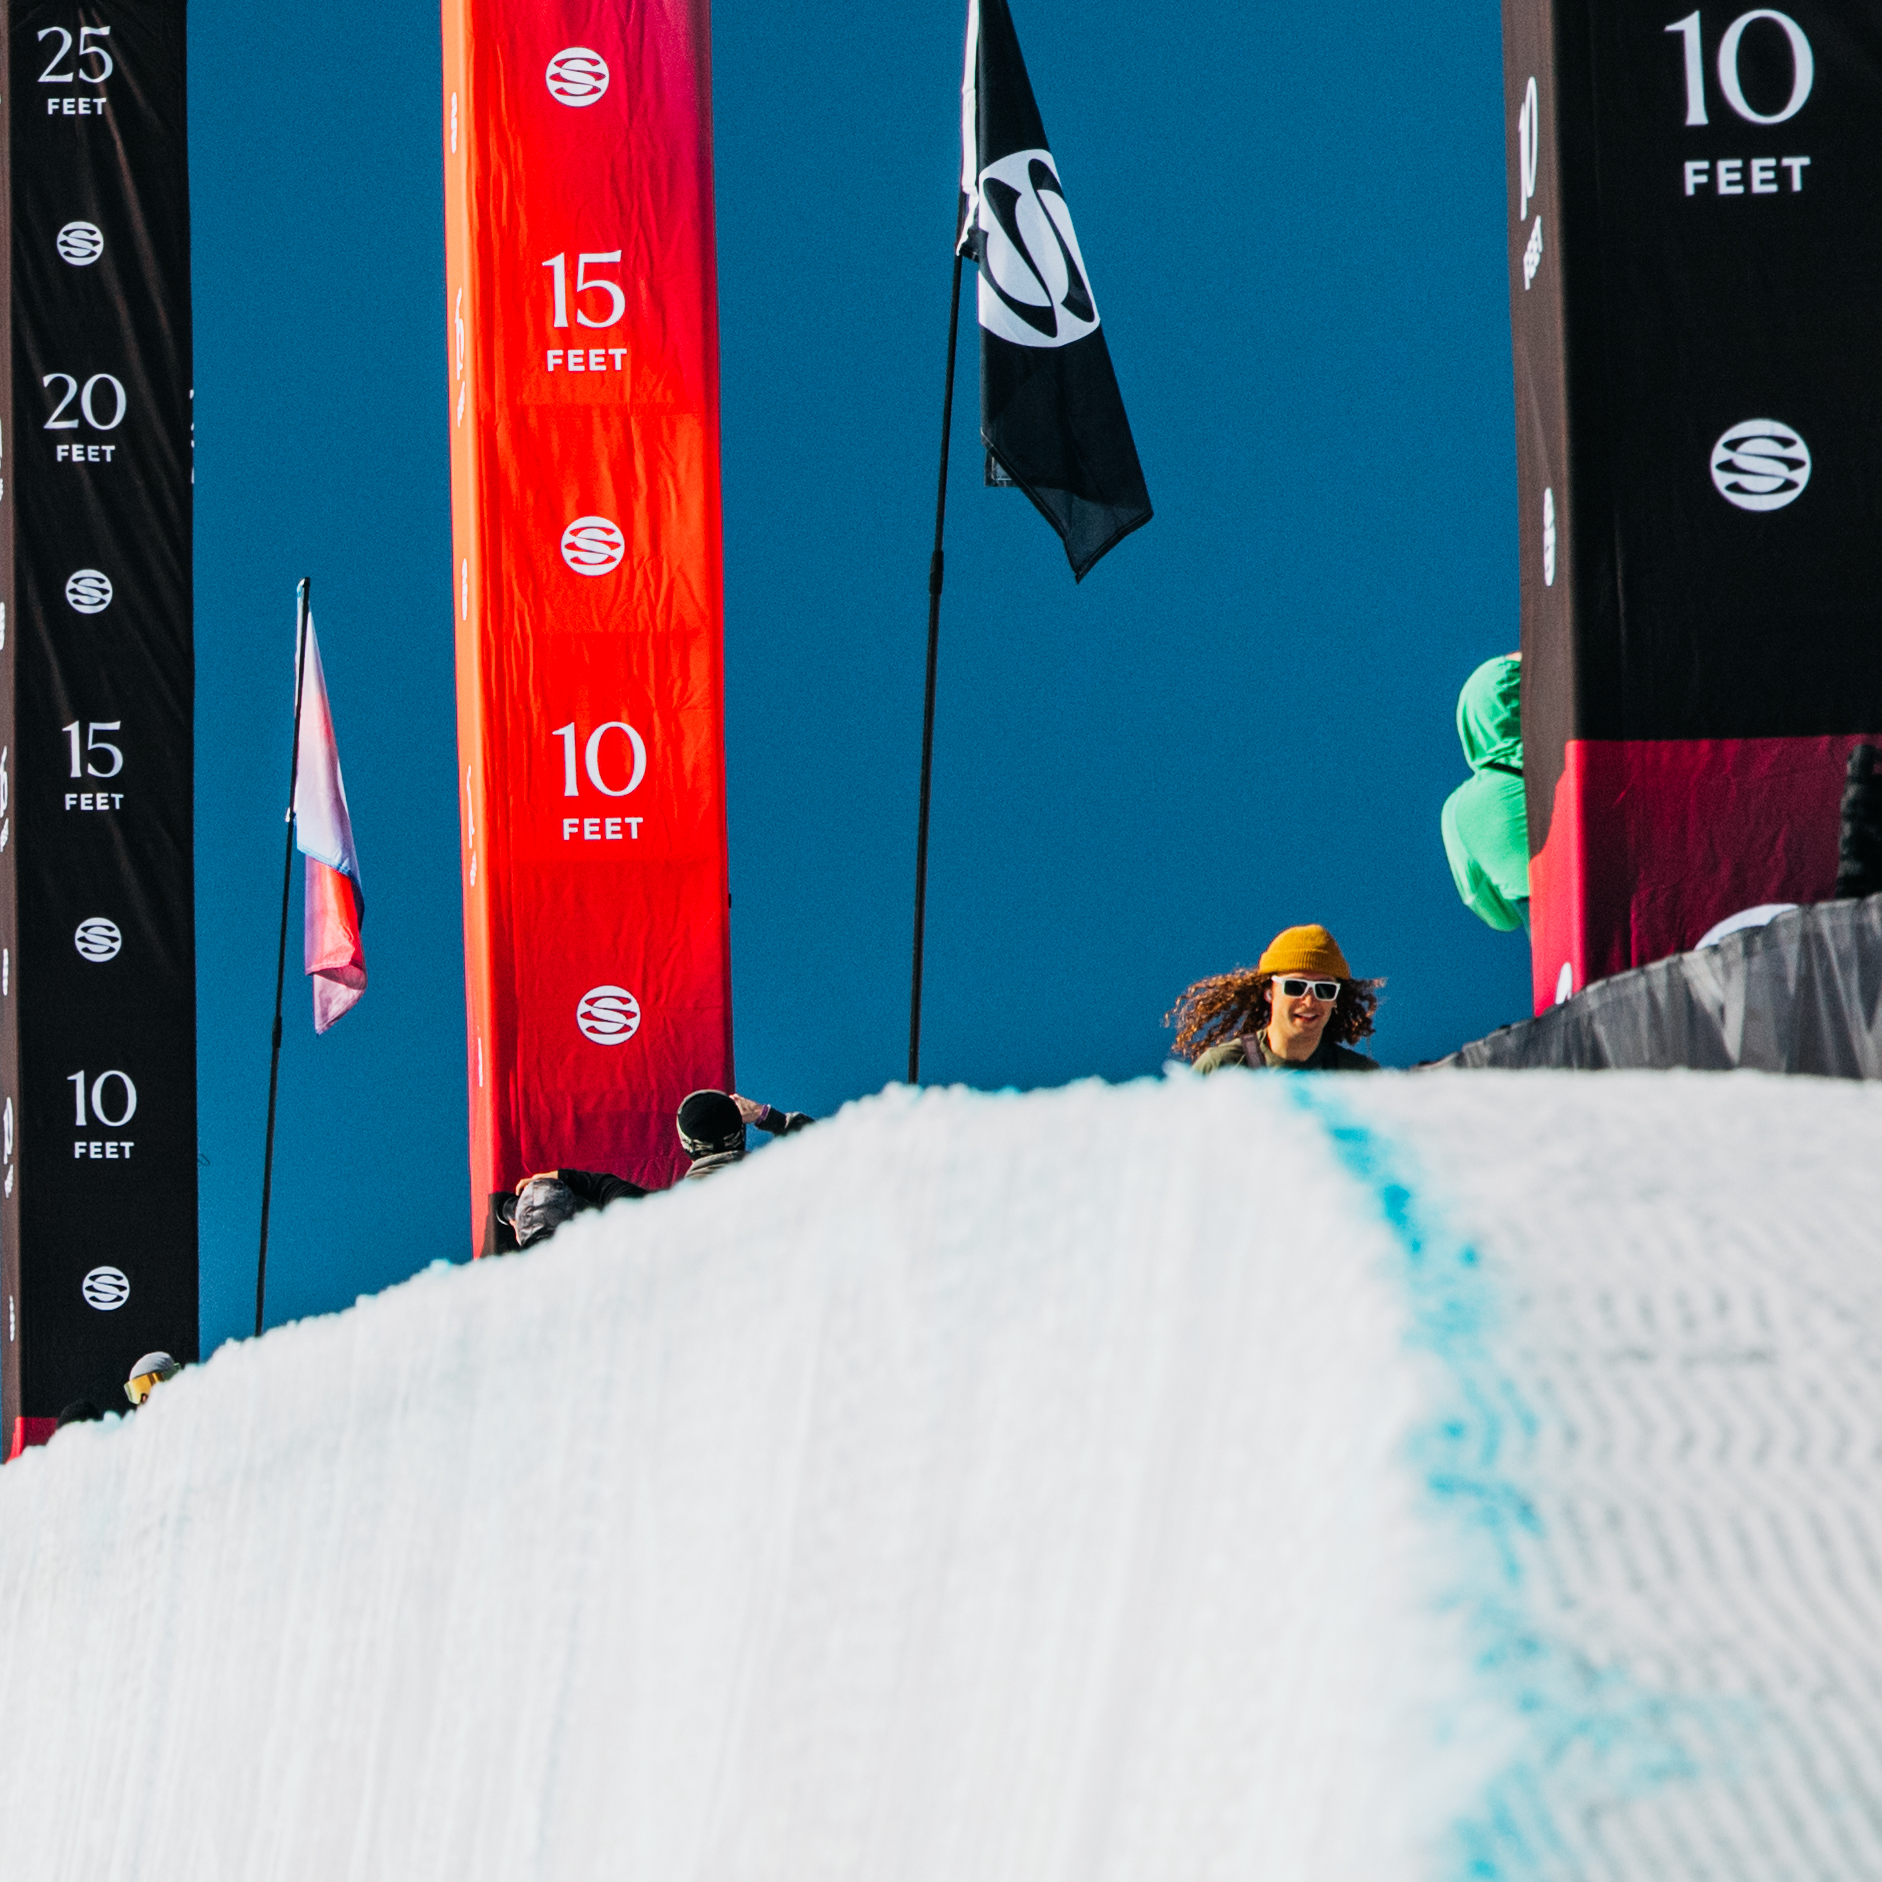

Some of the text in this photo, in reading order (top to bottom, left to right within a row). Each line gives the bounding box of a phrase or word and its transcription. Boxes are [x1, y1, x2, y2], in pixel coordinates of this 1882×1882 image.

[37, 25, 114, 84] 25
[1664, 9, 1814, 126] 10
[47, 97, 108, 116] FEET
[1684, 156, 1811, 197] FEET
[541, 249, 627, 329] 15
[546, 347, 628, 373] FEET
[42, 372, 127, 431] 20
[55, 443, 117, 463] FEET
[61, 719, 124, 779] 15
[551, 720, 648, 798] 10
[65, 792, 125, 811] FEET
[562, 816, 644, 842] FEET
[66, 1069, 138, 1128] 10
[74, 1141, 135, 1160] FEET
